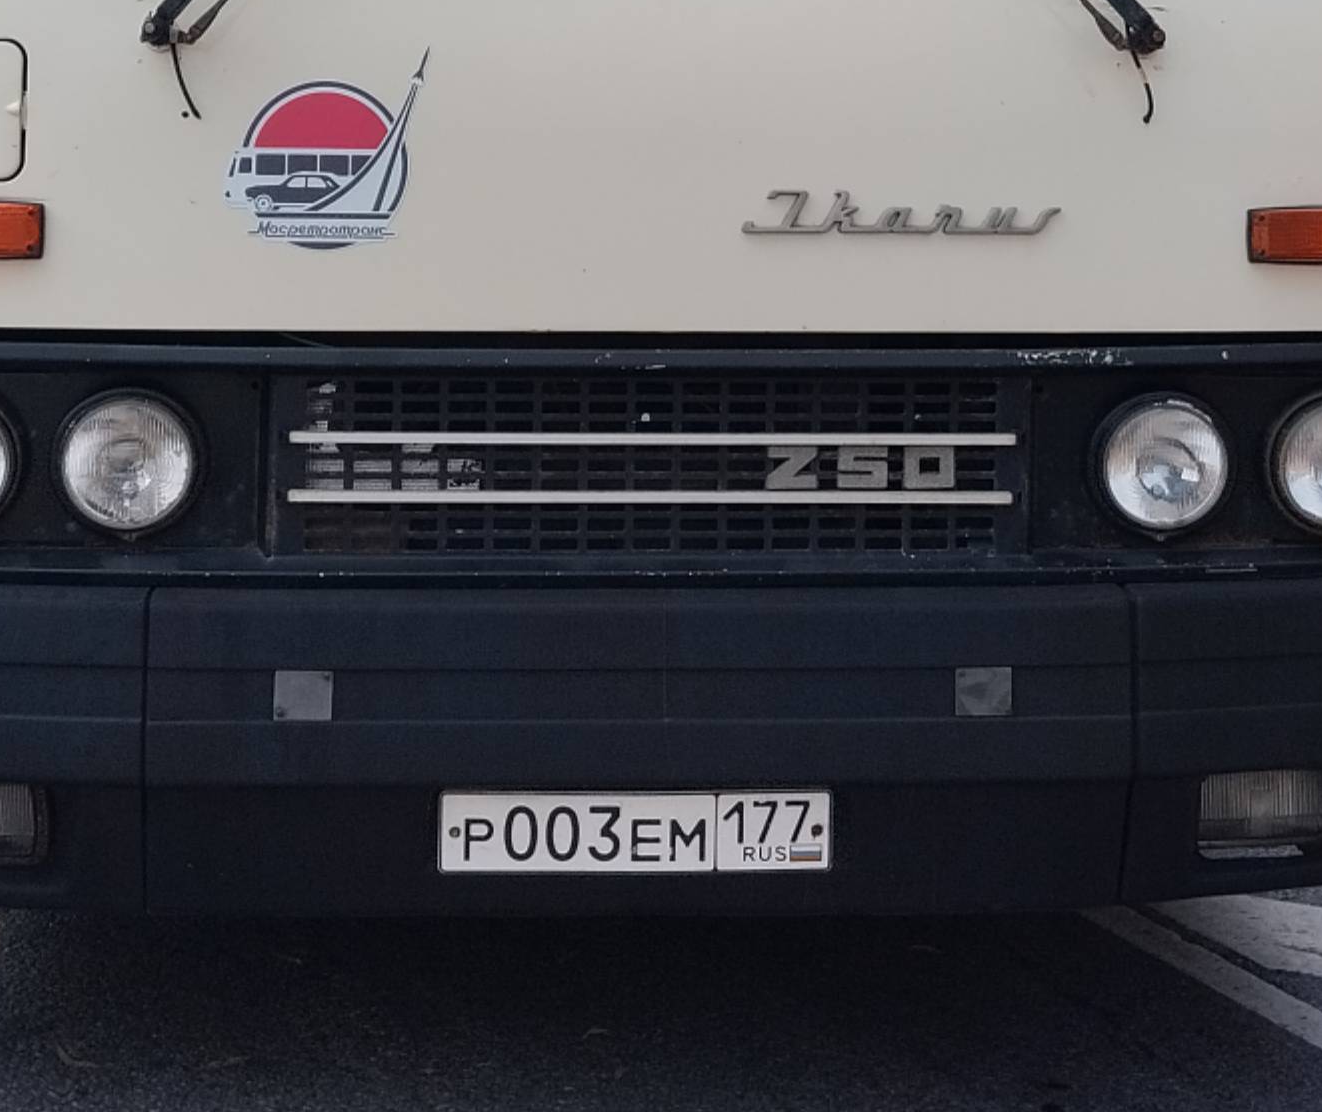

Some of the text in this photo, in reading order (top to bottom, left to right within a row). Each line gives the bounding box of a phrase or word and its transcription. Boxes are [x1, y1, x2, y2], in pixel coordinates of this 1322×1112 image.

[741, 190, 1062, 235] Ikarus
[765, 446, 955, 490] 250
[723, 800, 810, 844] 177
[742, 846, 787, 862] RUS
